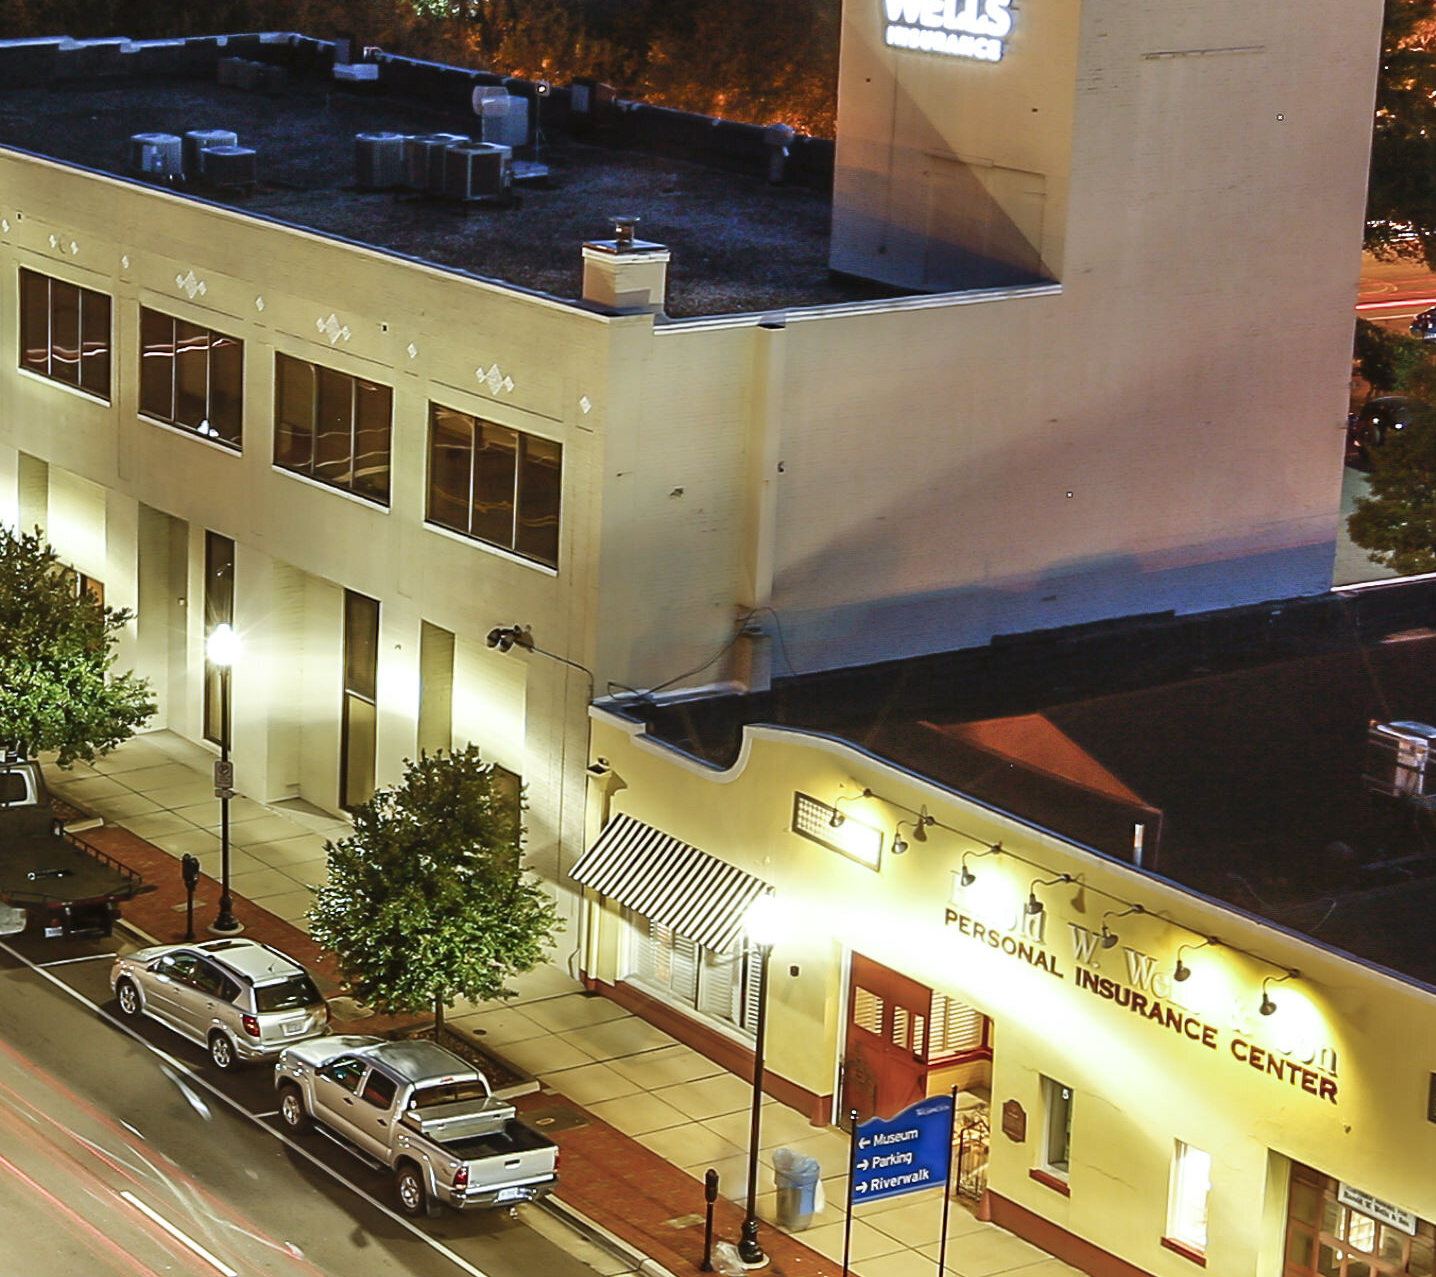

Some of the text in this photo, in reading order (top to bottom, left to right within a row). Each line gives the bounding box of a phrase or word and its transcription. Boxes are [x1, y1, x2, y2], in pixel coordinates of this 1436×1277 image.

[886, 25, 1003, 62] INSURANCE
[945, 908, 1339, 1105] PERSONAL INSURANCE CENTER
[873, 1129, 918, 1147] Museum
[872, 1152, 913, 1169] Parking
[870, 1168, 930, 1191] Riverwalk
